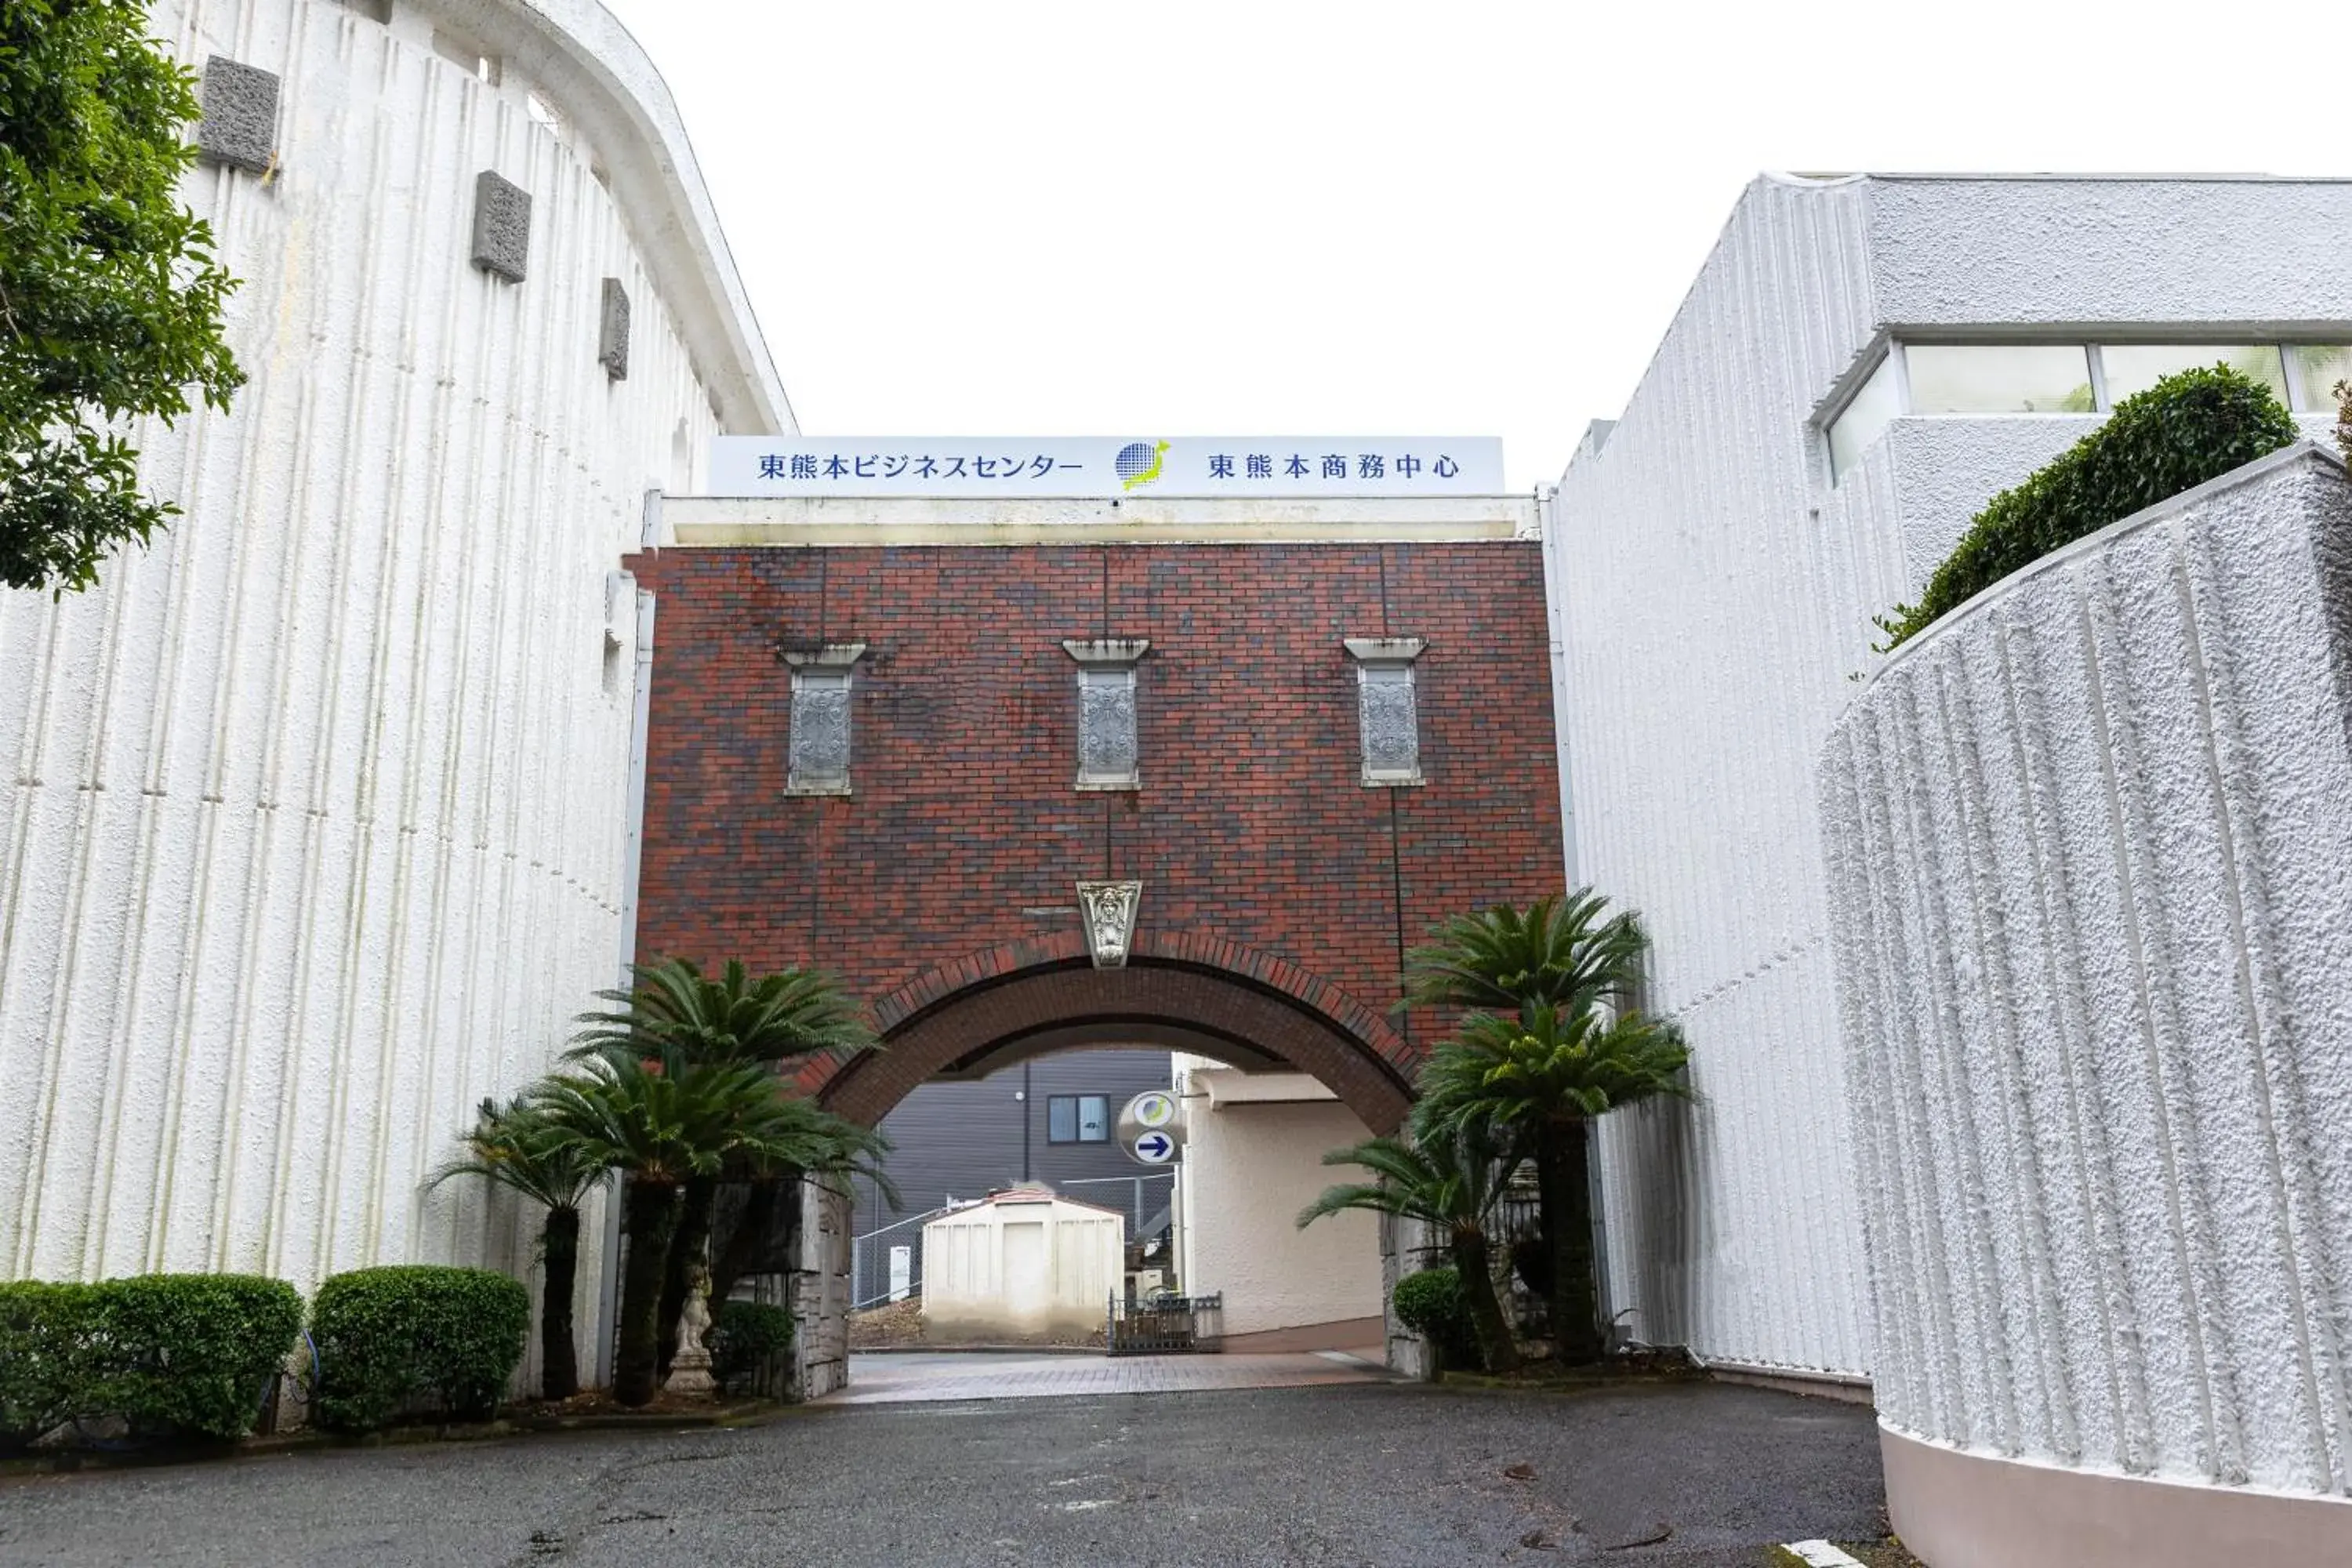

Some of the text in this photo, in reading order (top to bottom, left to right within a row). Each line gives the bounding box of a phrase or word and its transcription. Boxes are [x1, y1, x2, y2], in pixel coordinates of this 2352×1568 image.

[757, 454, 1083, 480] 東熊本ビジネスセンター
[1207, 453, 1460, 479] 東熊本商務中心
